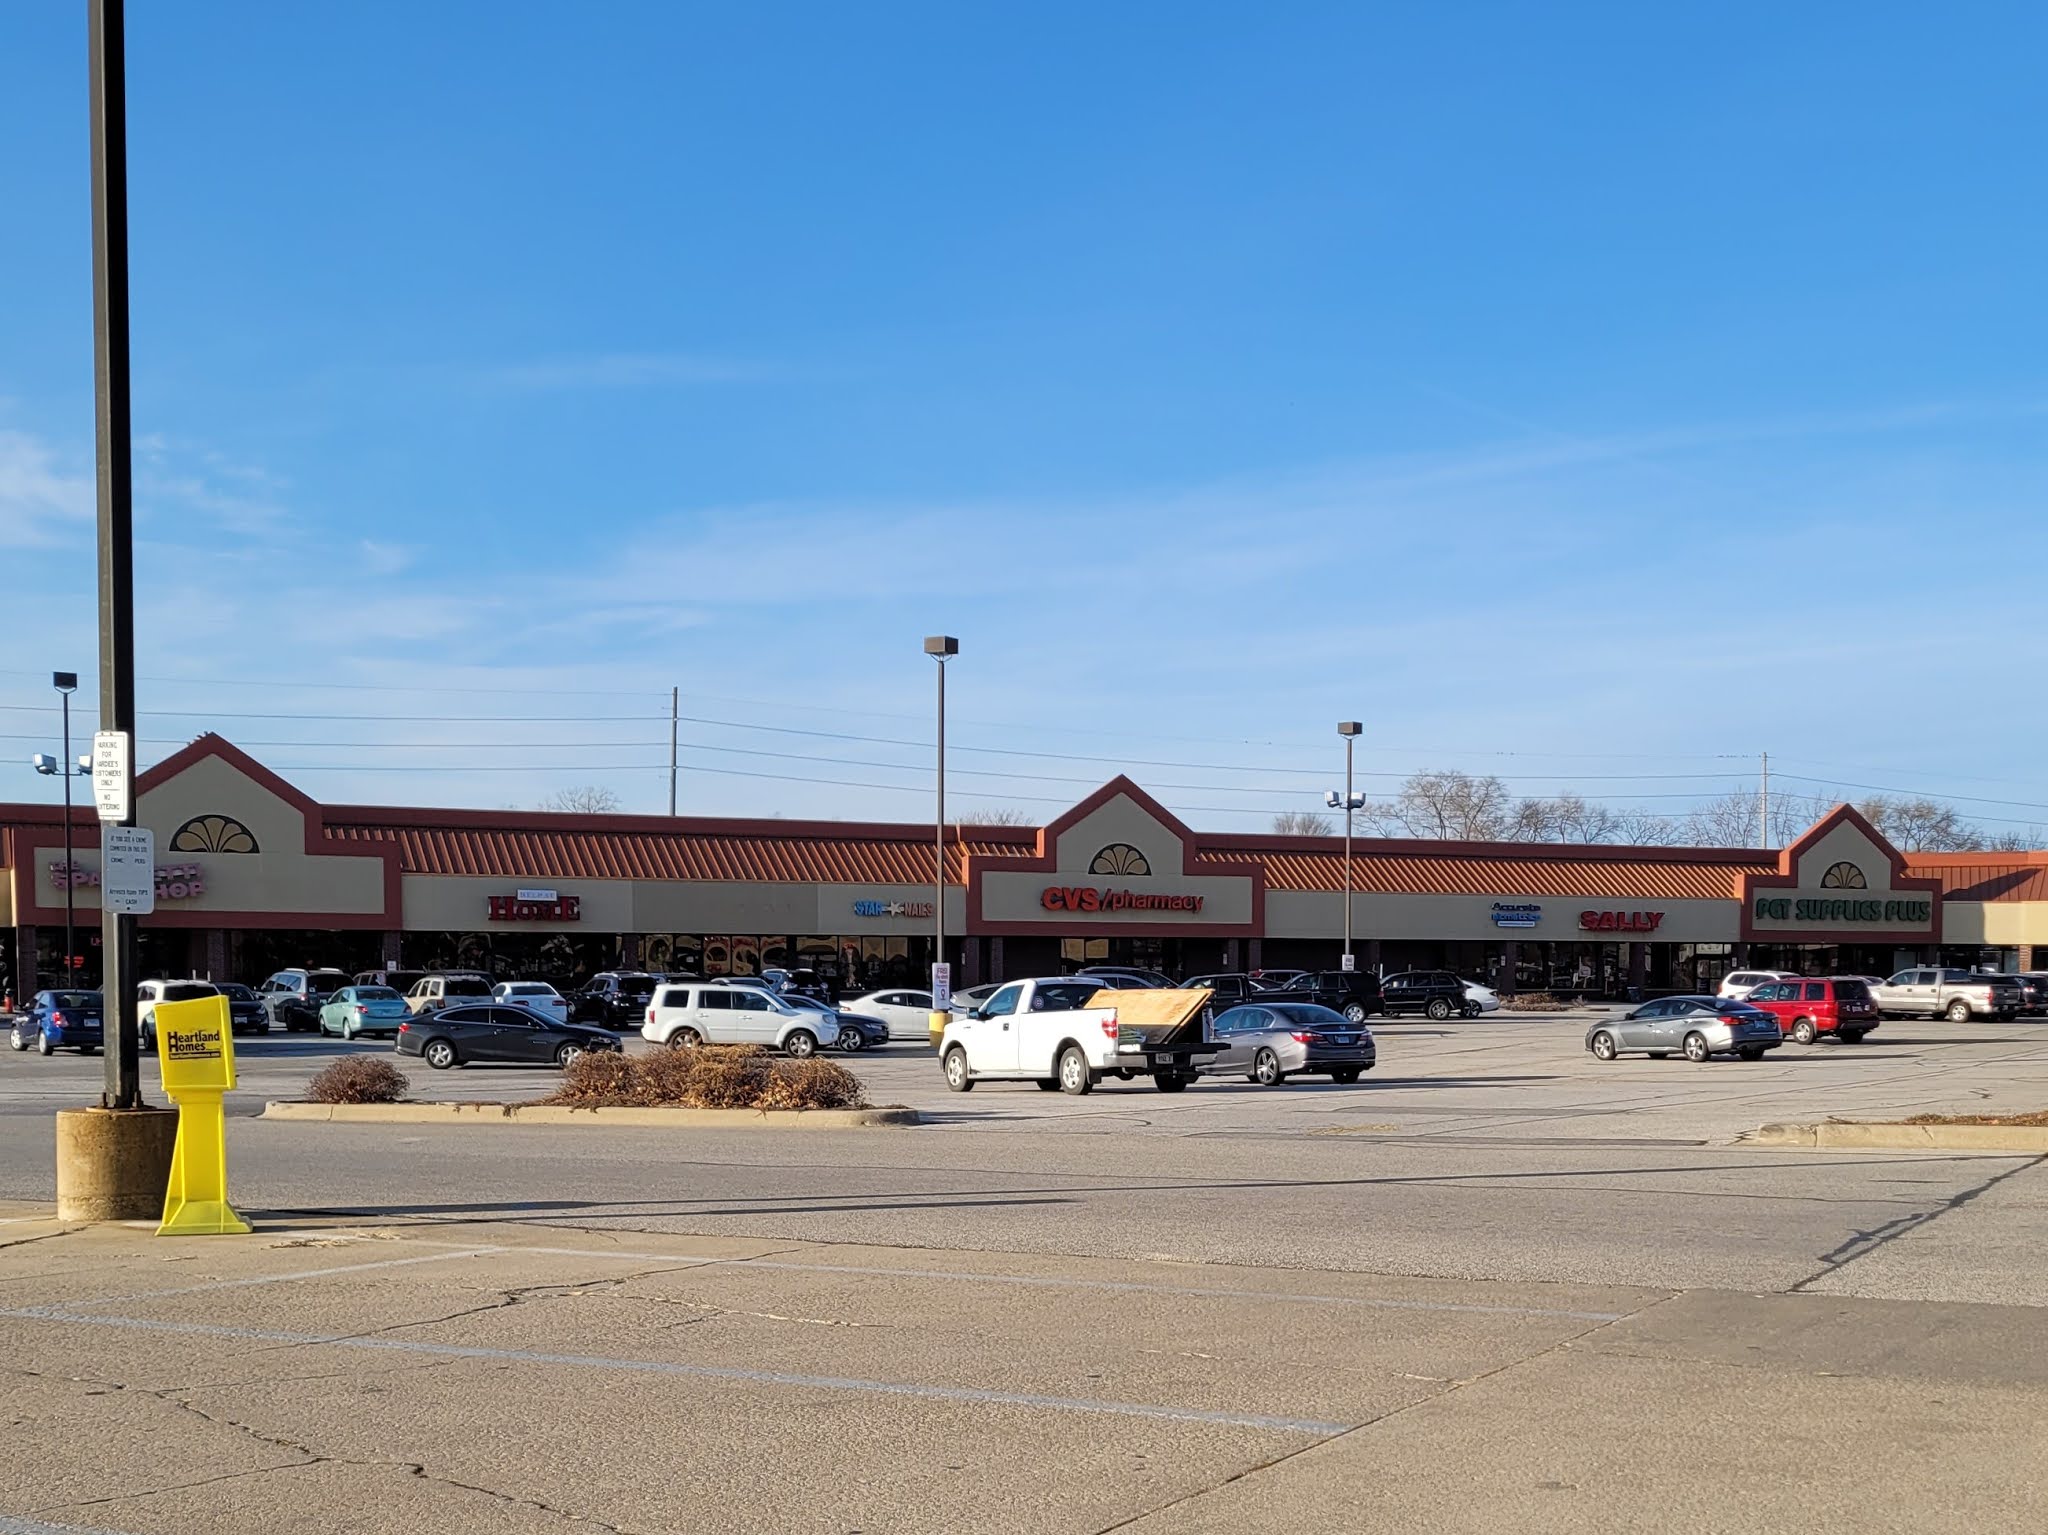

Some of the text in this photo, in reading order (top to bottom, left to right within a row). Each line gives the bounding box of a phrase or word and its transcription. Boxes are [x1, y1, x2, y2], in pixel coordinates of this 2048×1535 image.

[854, 899, 934, 918] STAR NAILS
[1756, 897, 1931, 922] PET SUPPLIES PLUS
[1579, 911, 1666, 928] SALLY
[167, 1029, 220, 1044] Heartland
[168, 1041, 206, 1053] Homes
